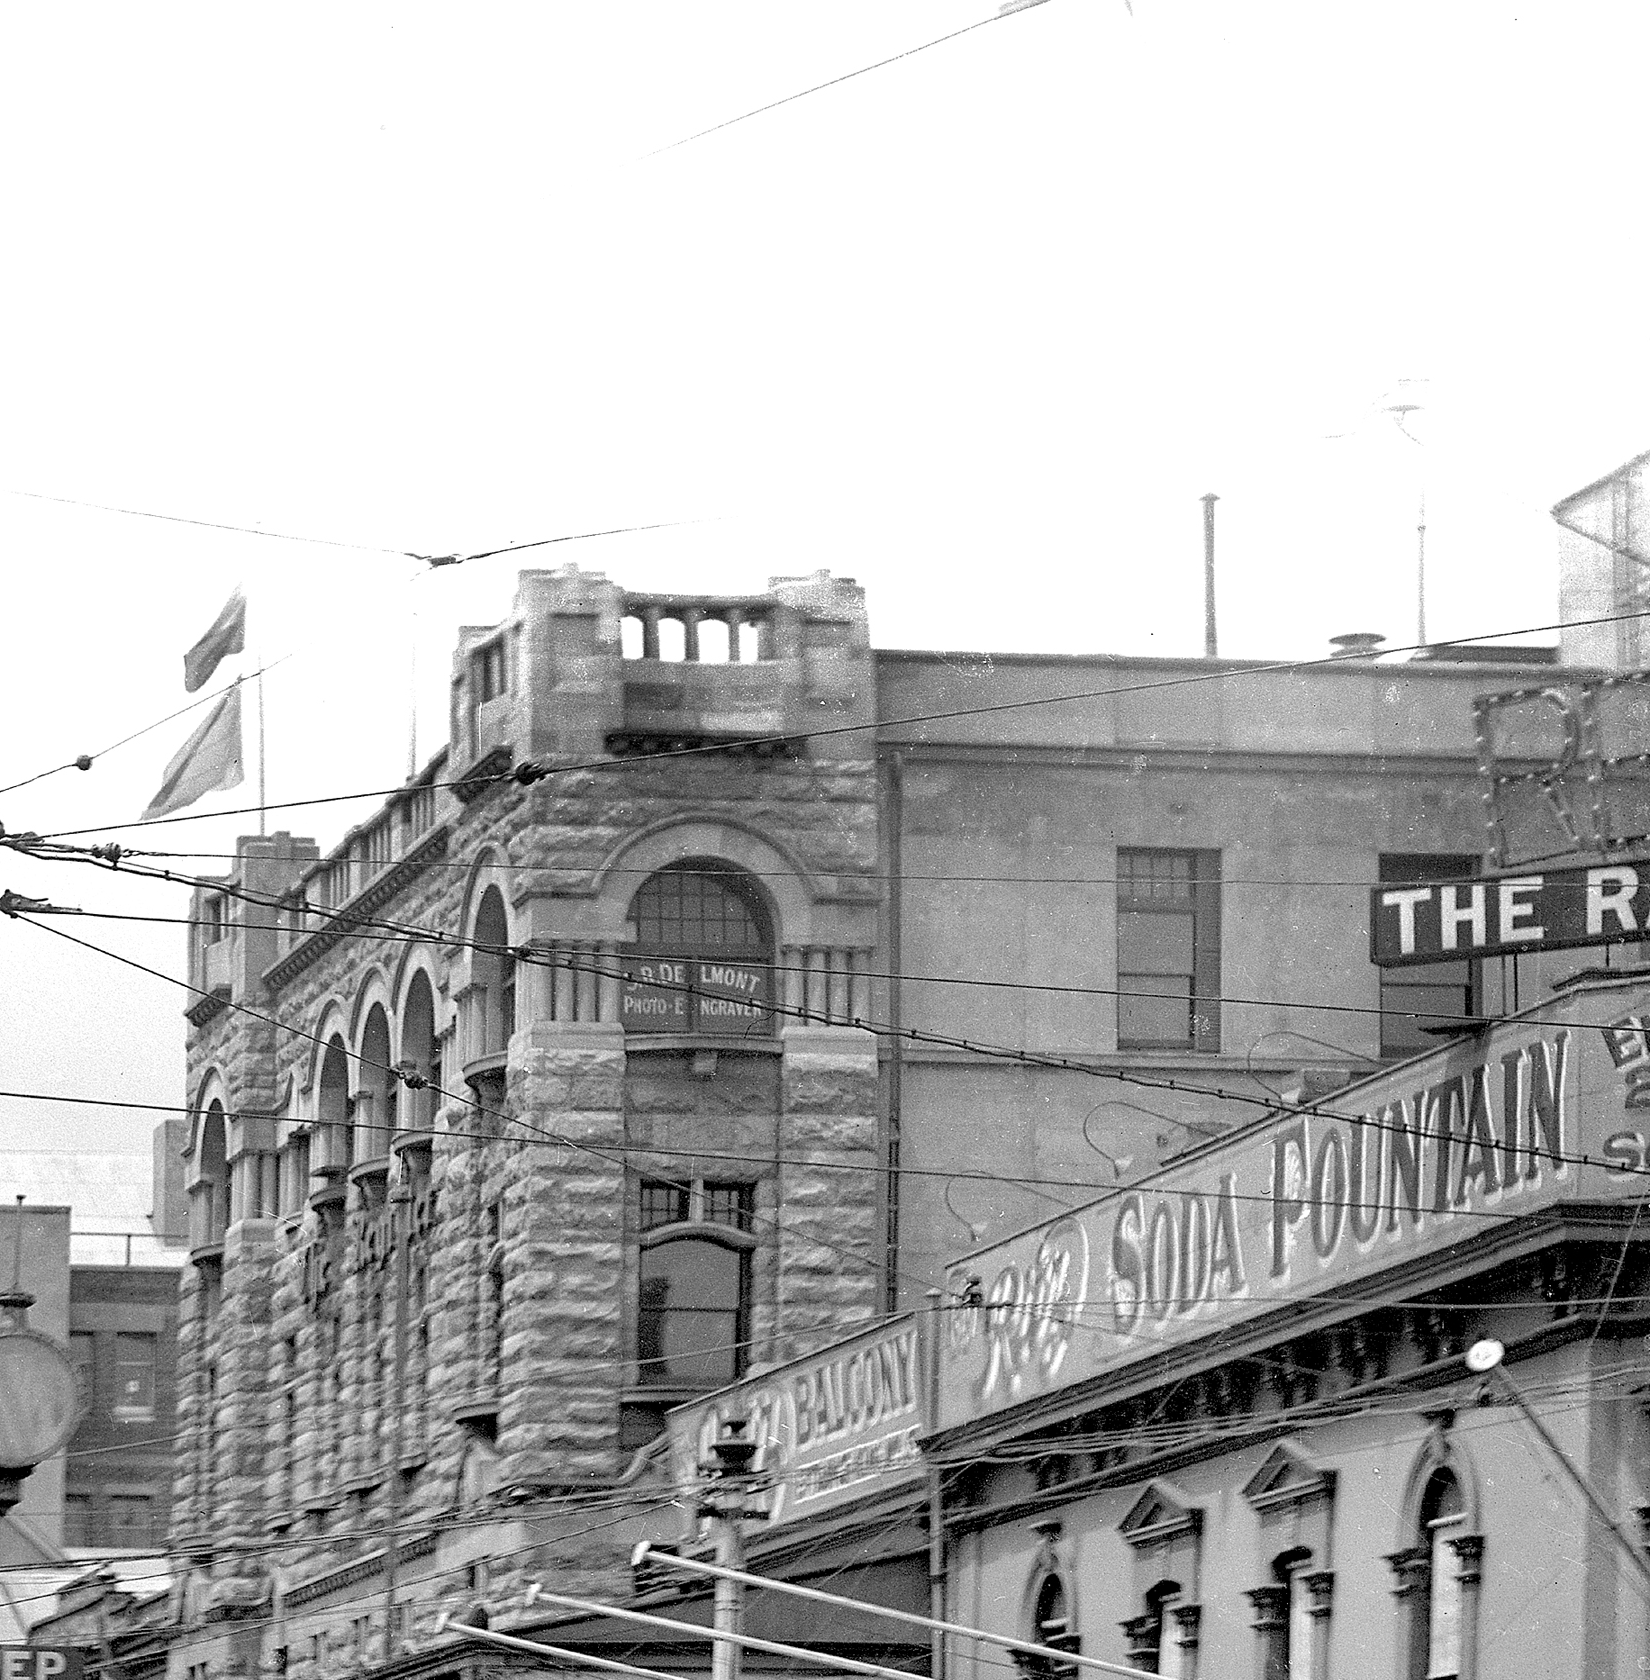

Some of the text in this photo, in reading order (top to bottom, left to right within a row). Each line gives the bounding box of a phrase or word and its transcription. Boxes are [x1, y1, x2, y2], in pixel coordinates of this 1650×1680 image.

[1381, 865, 1650, 954] THE R
[1112, 1170, 1249, 1341] SODA
[1268, 1030, 1572, 1286] FOUNTAIN
